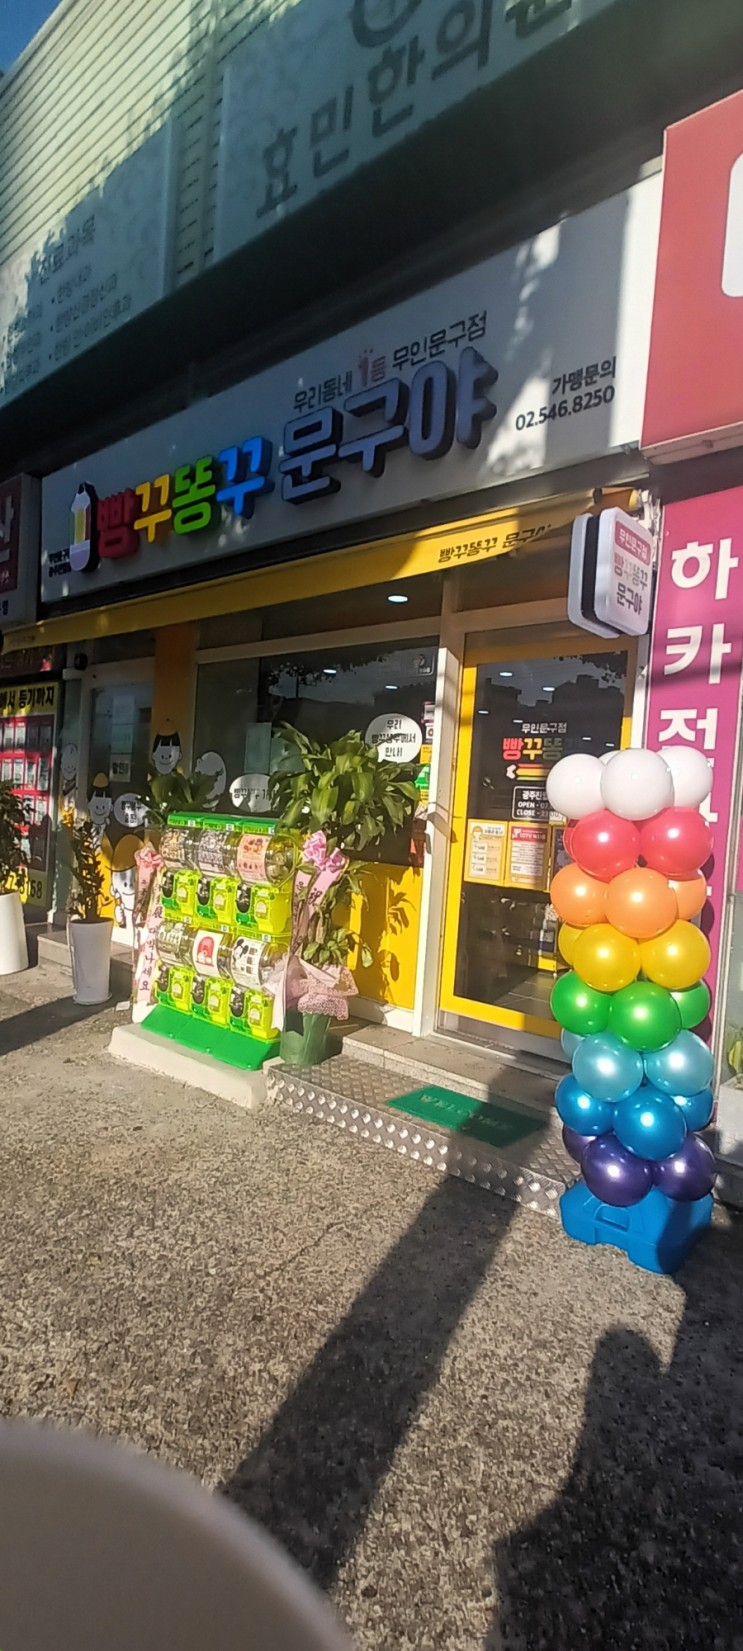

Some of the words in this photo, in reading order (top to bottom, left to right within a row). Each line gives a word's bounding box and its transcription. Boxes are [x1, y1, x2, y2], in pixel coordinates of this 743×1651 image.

[294, 371, 352, 412] 우리동네
[392, 310, 487, 371] 무인문구점
[551, 356, 616, 396] 가맹문의
[514, 386, 616, 431] 02.546.8250
[97, 436, 273, 560] 빵꾸똥꾸
[278, 346, 497, 504] 문구야
[438, 537, 498, 563] 빵꾸똥꾸
[618, 527, 648, 560] 무인문구점
[613, 552, 648, 591] 빵꾸똥꾸
[616, 582, 643, 615] 문구야
[19, 686, 54, 709] 등기까지
[387, 719, 402, 730] 우리
[521, 722, 567, 734] 무인문구점
[516, 809, 535, 817] CLOSE
[517, 801, 535, 809] OPEN
